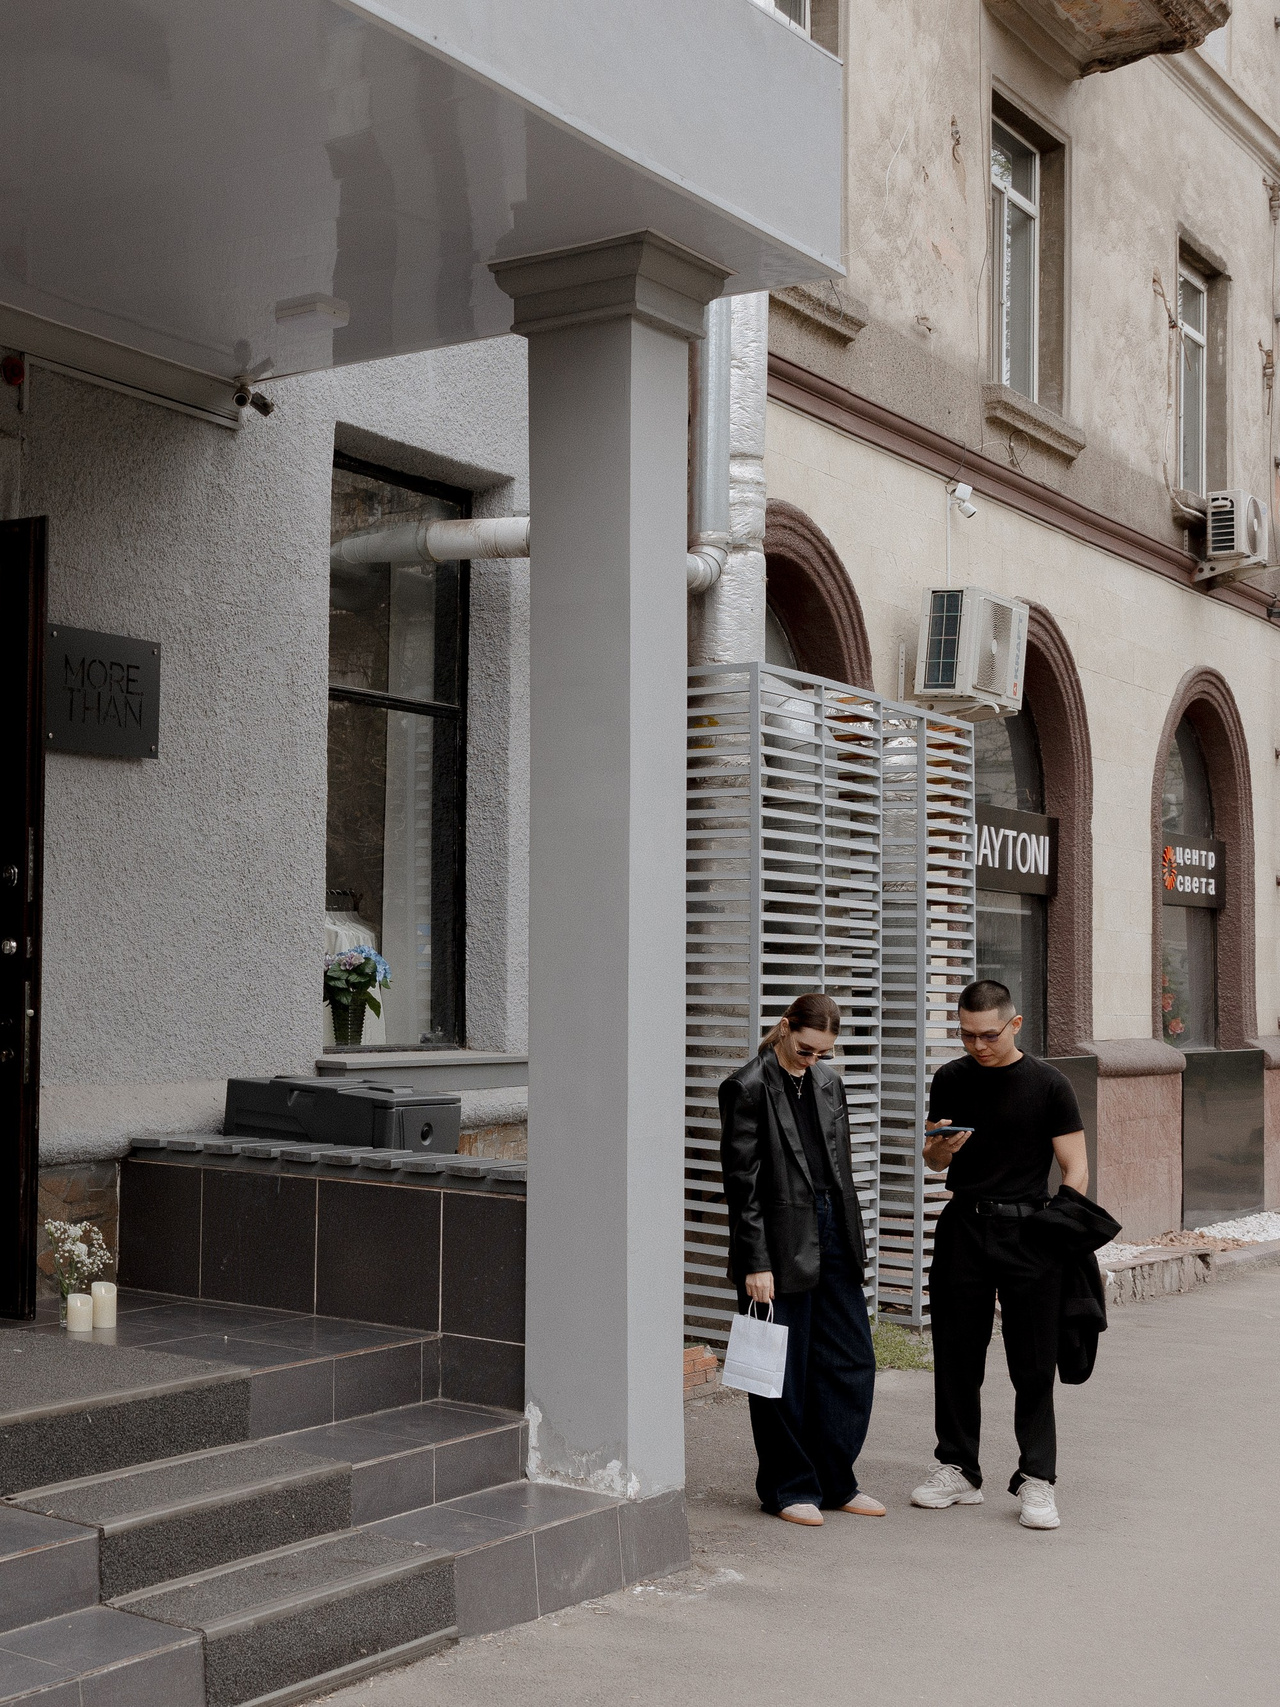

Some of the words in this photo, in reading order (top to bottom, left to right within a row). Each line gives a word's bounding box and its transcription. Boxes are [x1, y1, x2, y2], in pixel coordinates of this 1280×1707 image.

[64, 653, 144, 697] MORE
[63, 686, 143, 730] THAN
[1175, 846, 1216, 871] центр
[1176, 875, 1216, 895] света
